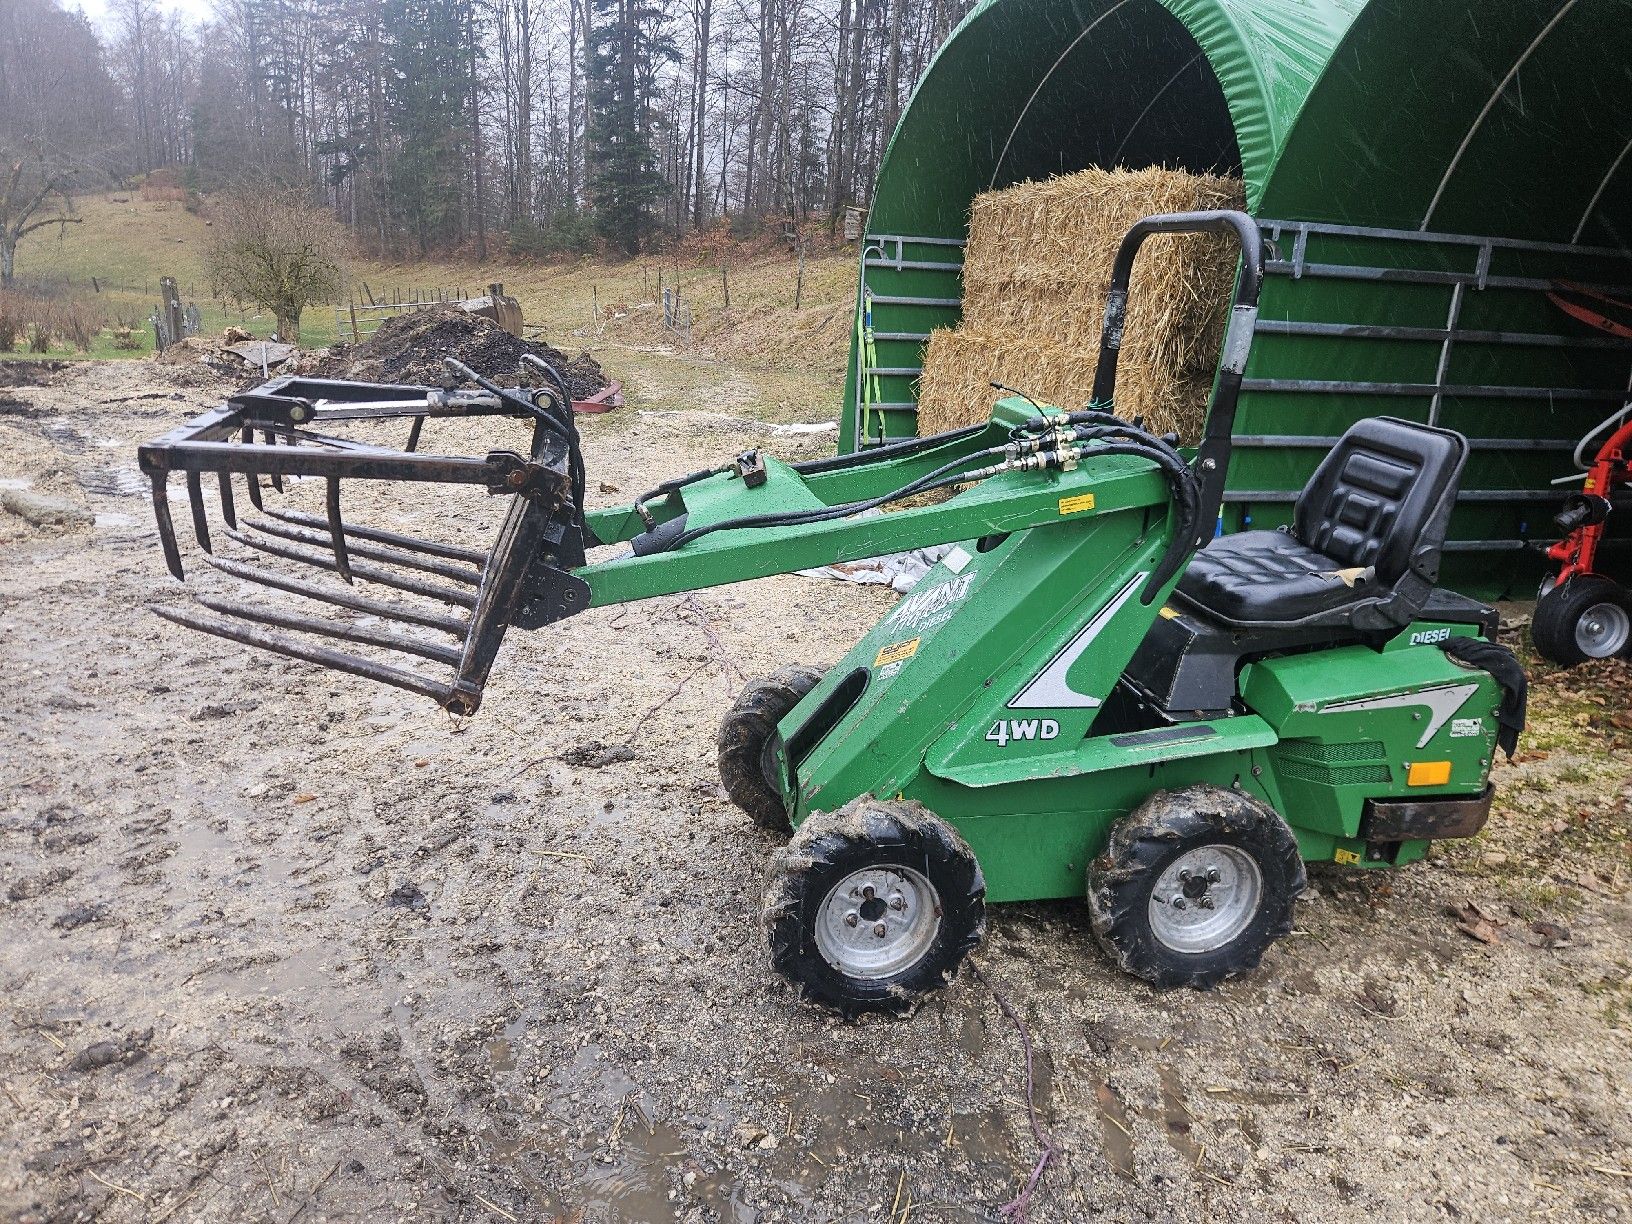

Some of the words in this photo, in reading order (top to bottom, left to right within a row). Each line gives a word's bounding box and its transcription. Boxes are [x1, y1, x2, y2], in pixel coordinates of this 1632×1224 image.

[880, 570, 978, 628] AVANT
[918, 609, 954, 633] DIESEL
[985, 719, 1060, 747] 4WD
